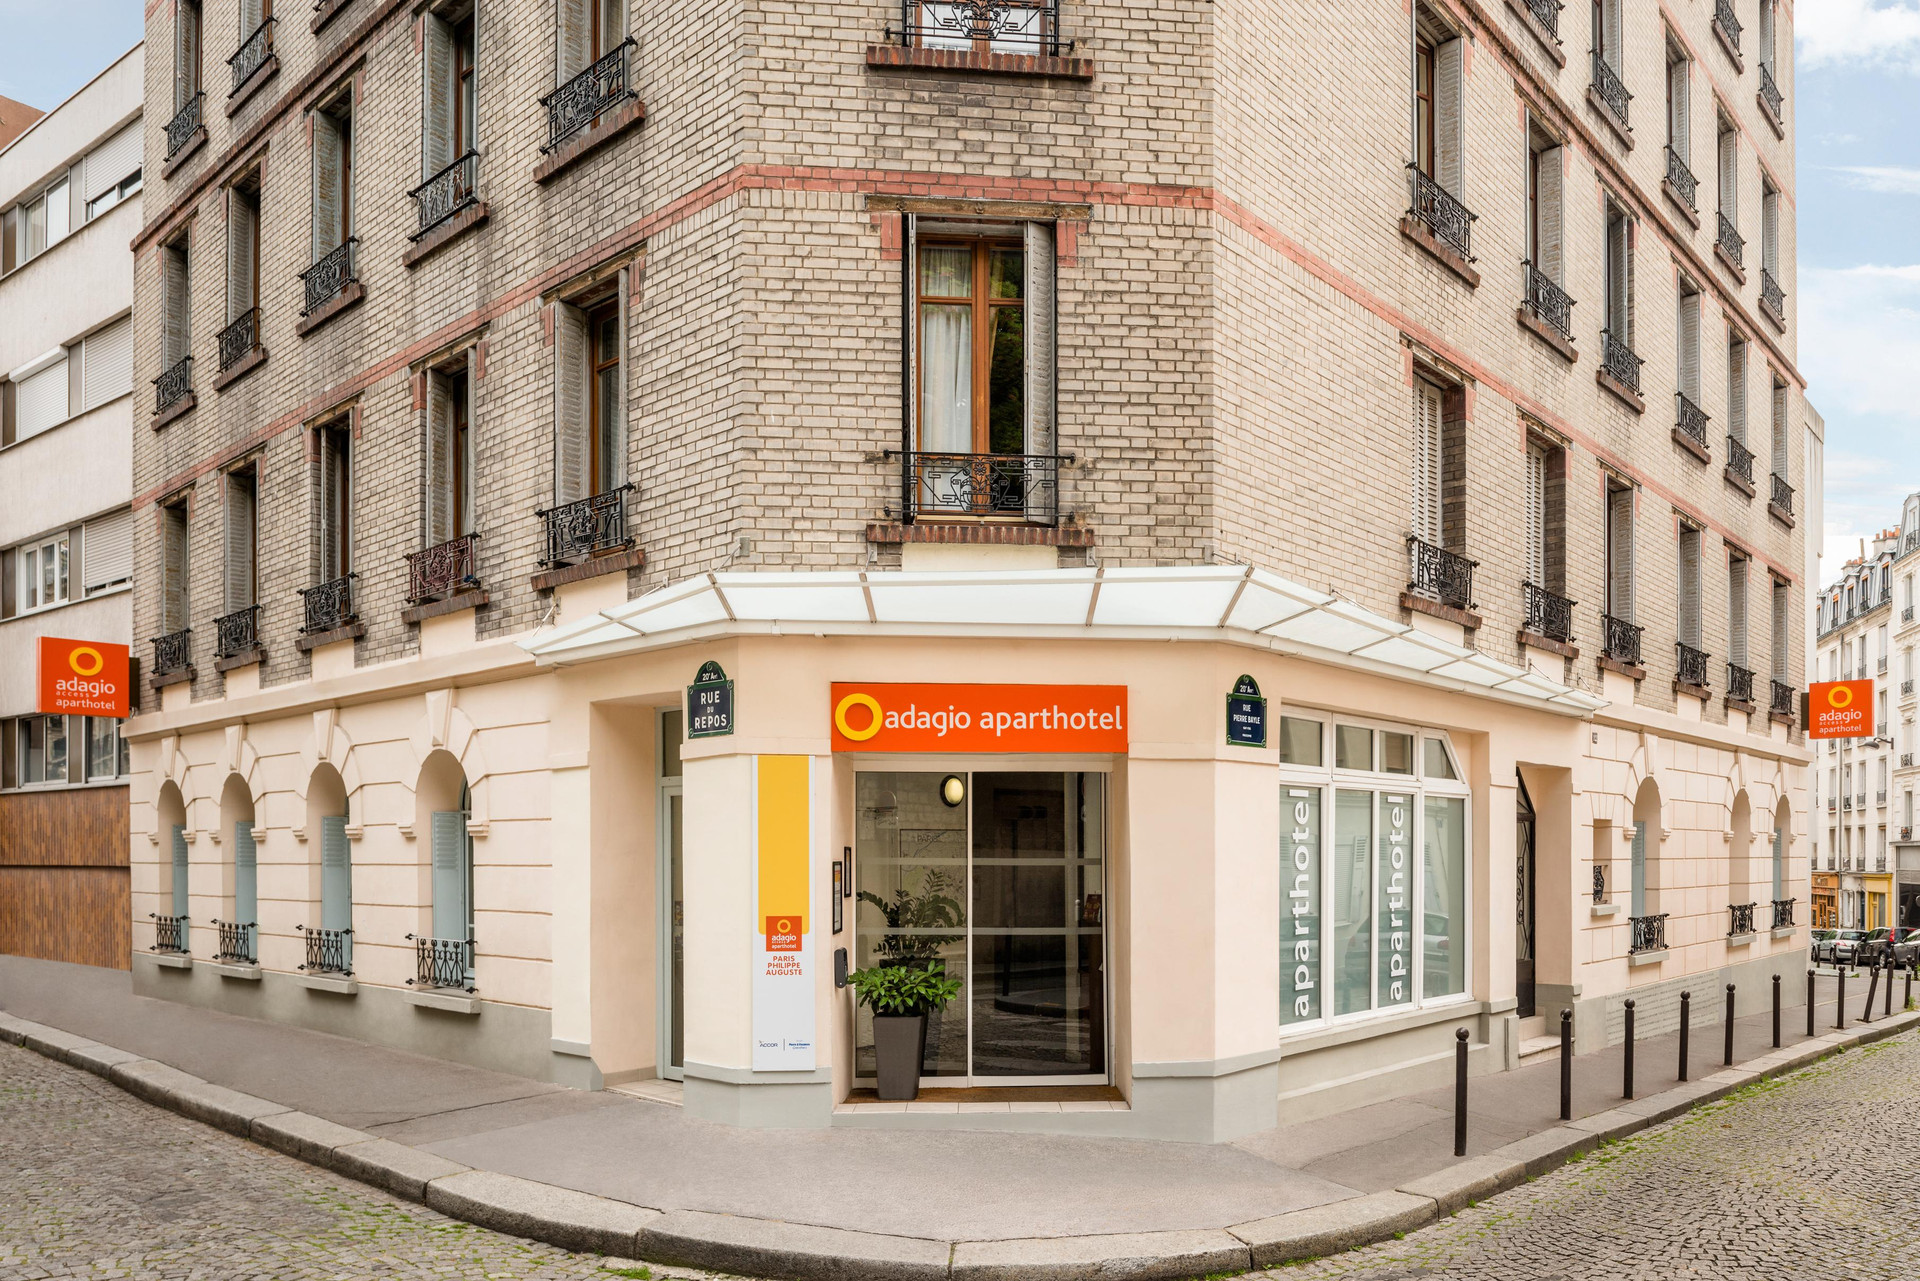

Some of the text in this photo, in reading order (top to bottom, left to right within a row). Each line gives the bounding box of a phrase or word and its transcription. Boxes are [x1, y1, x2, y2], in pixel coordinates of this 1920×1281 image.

[56, 676, 116, 698] adagio
[56, 698, 116, 710] aparthotel
[700, 690, 720, 704] RUE
[1242, 704, 1252, 712] RUE
[694, 714, 727, 730] REPOS
[884, 704, 1123, 737] adagio aparthotel
[1233, 714, 1248, 723] PIERRE
[1819, 708, 1862, 724] adagio
[1819, 724, 1862, 735] aparthotel
[1289, 789, 1314, 1017] aparthotel
[1386, 796, 1406, 1000] aparthotel
[772, 934, 796, 944] adagio
